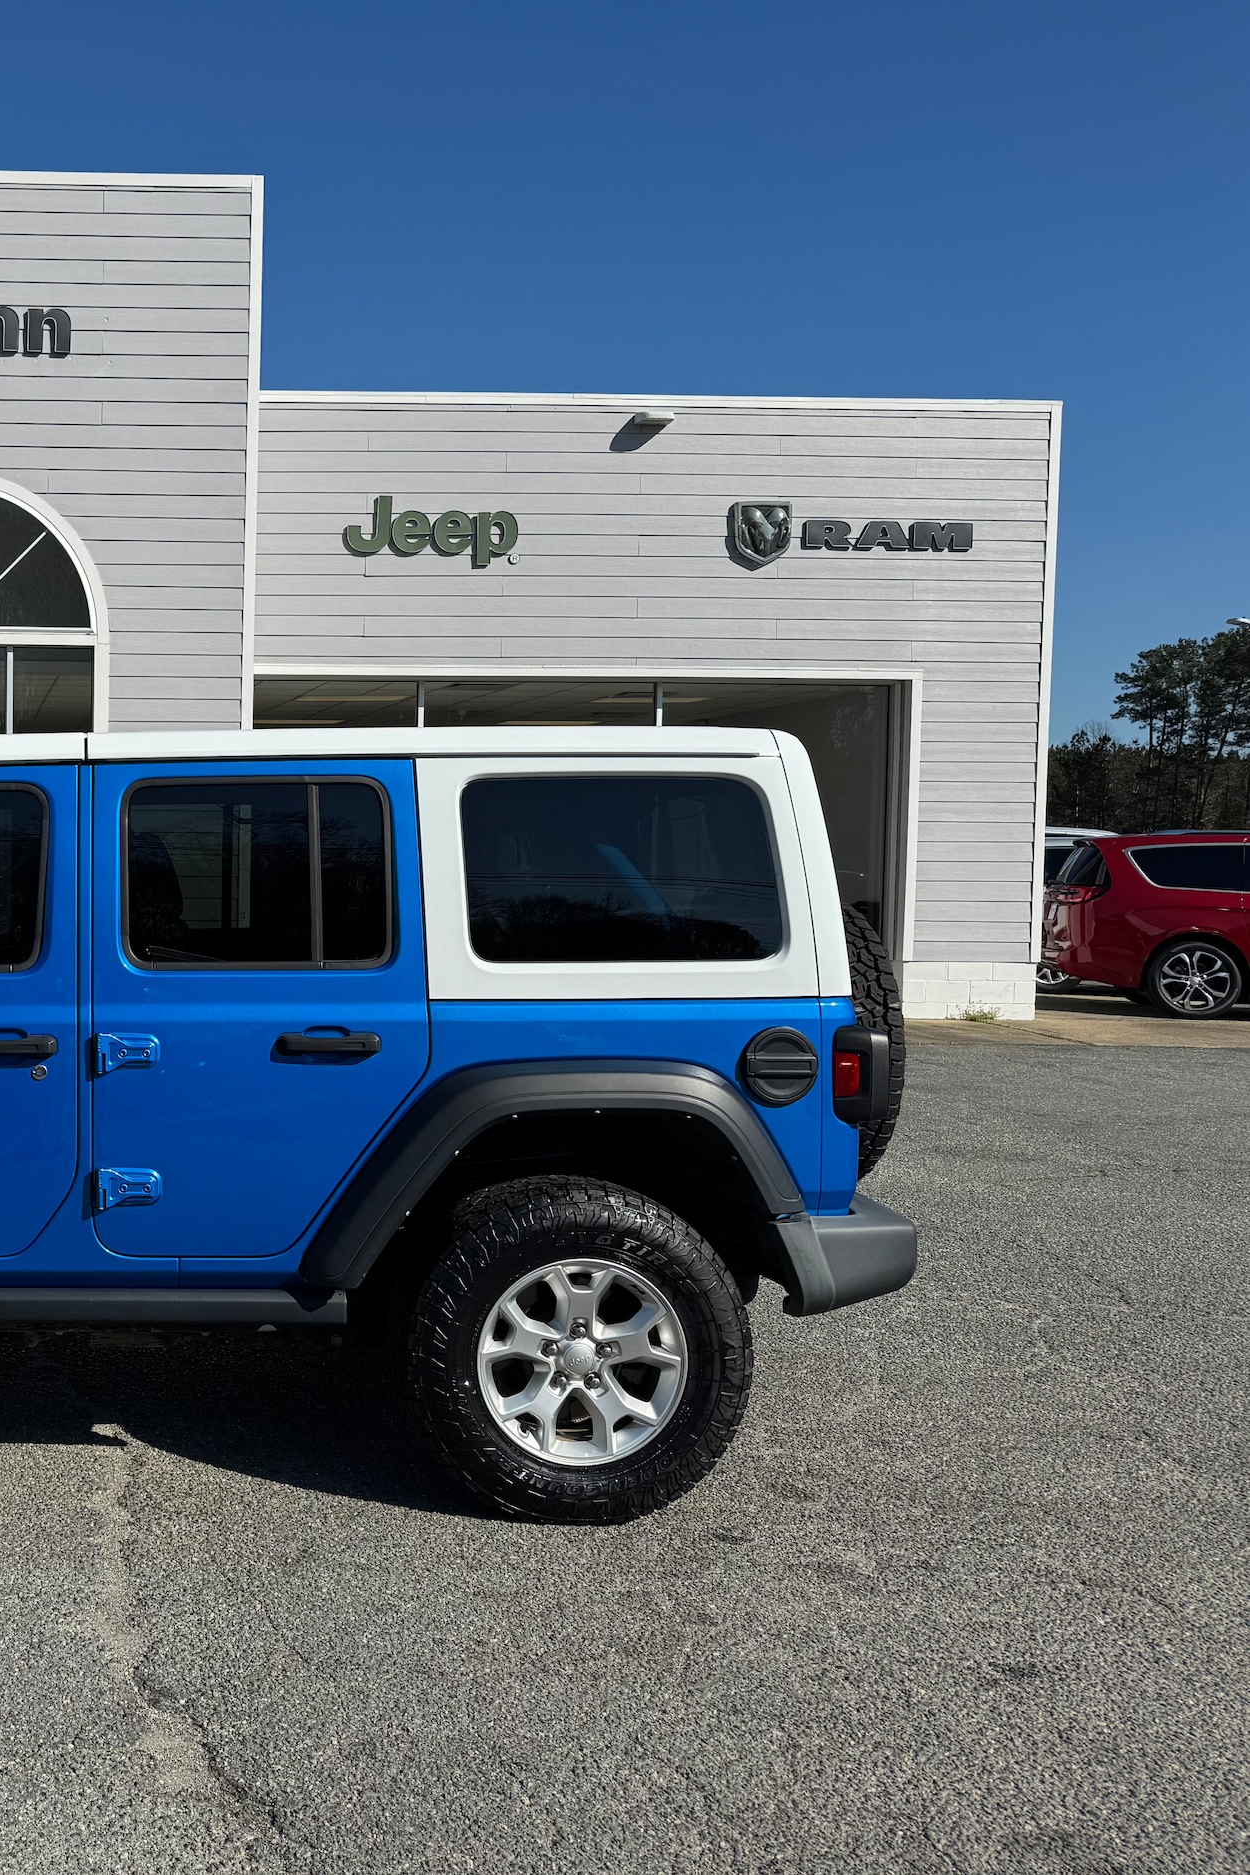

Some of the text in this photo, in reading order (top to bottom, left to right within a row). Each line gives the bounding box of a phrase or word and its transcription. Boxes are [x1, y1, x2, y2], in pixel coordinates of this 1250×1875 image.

[343, 496, 518, 569] Jeep
[800, 520, 973, 552] RAM
[621, 1237, 701, 1295] TIRES
